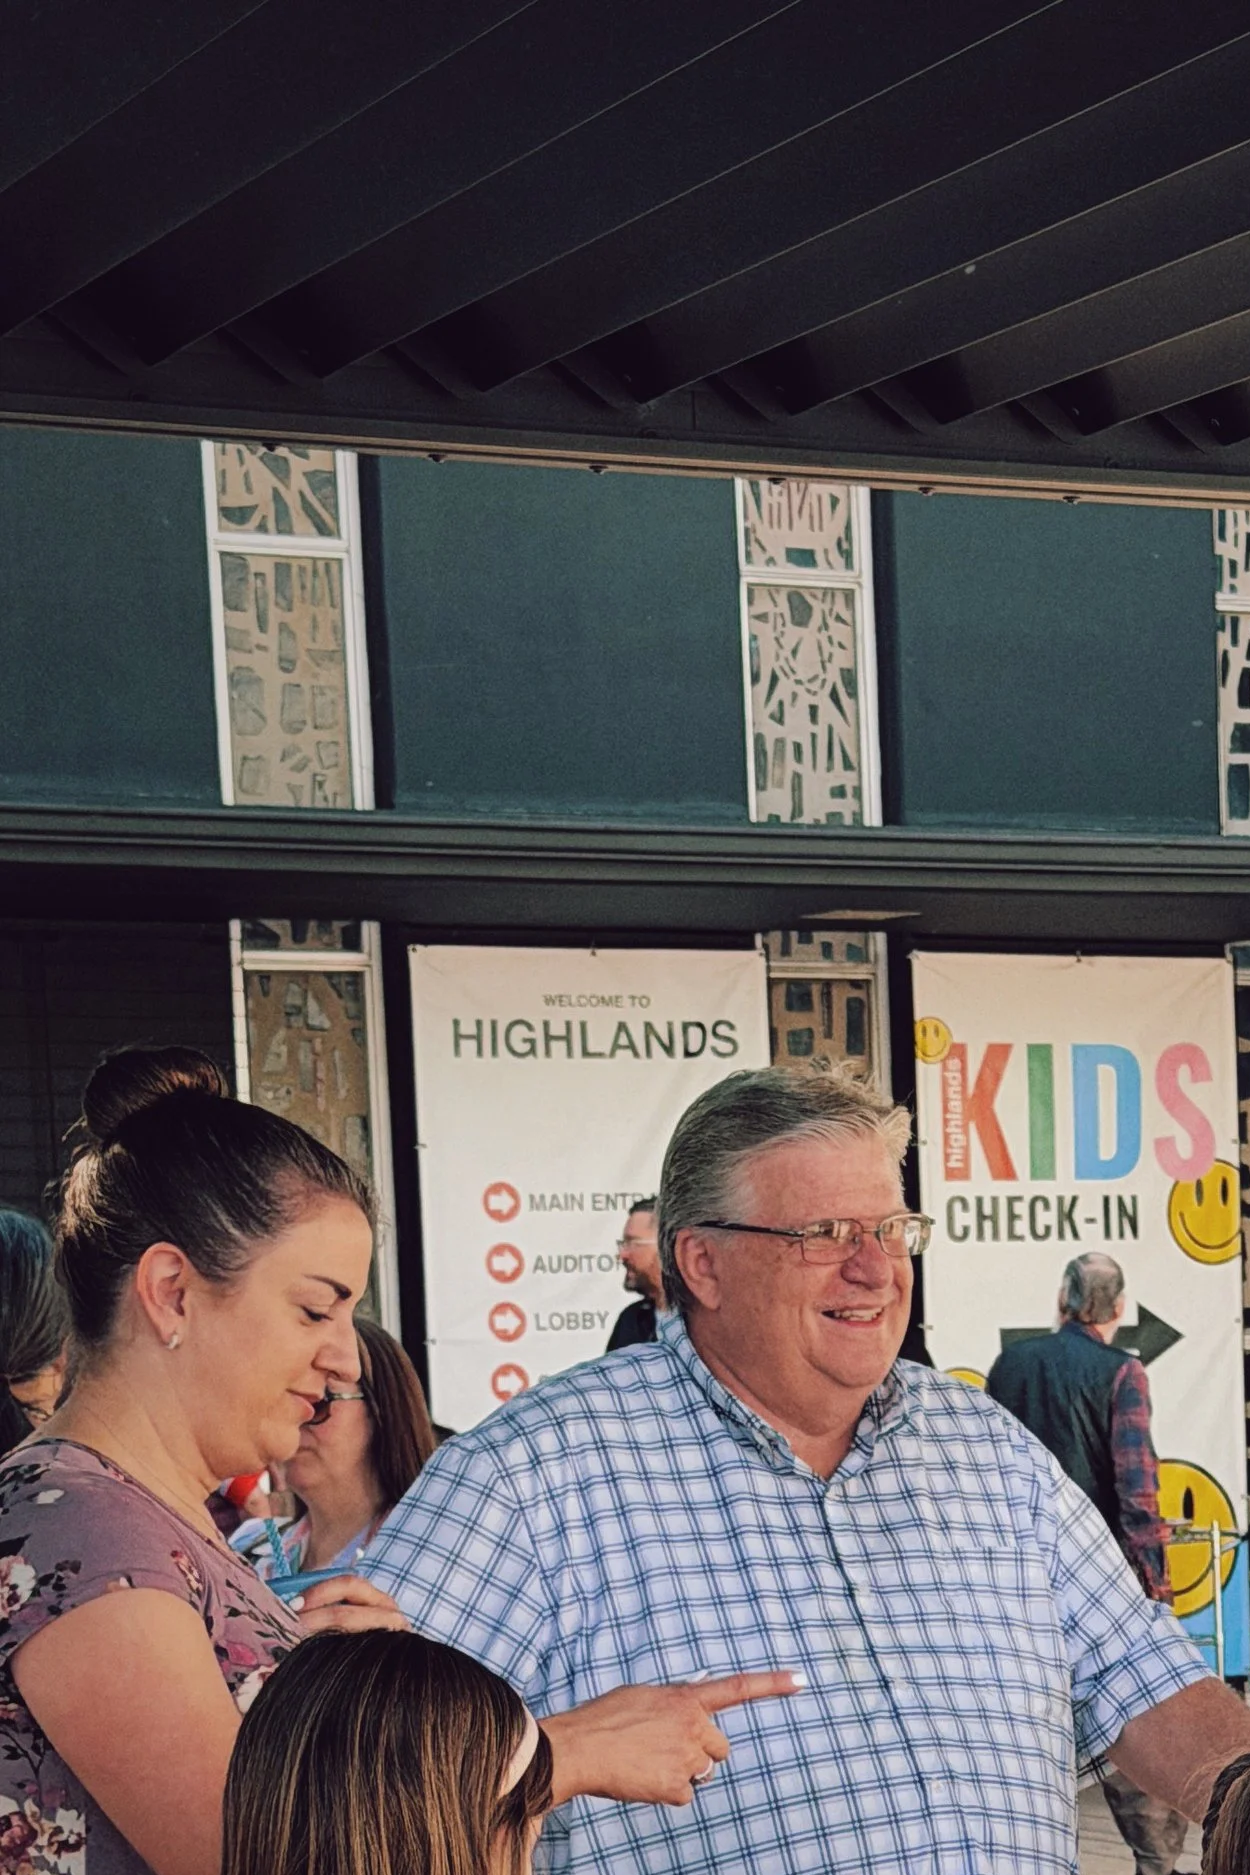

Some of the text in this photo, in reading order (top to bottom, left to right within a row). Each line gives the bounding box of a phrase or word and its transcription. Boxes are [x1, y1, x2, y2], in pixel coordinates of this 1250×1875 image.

[542, 993, 651, 1009] WELCOME TO
[451, 1018, 740, 1060] HIGHLANDS
[941, 1042, 1217, 1182] KIDS
[944, 1056, 967, 1168] highlands
[529, 1192, 657, 1212] MAIN ENTR
[946, 1195, 1140, 1243] CHECK-IN
[535, 1311, 609, 1332] LOBBY
